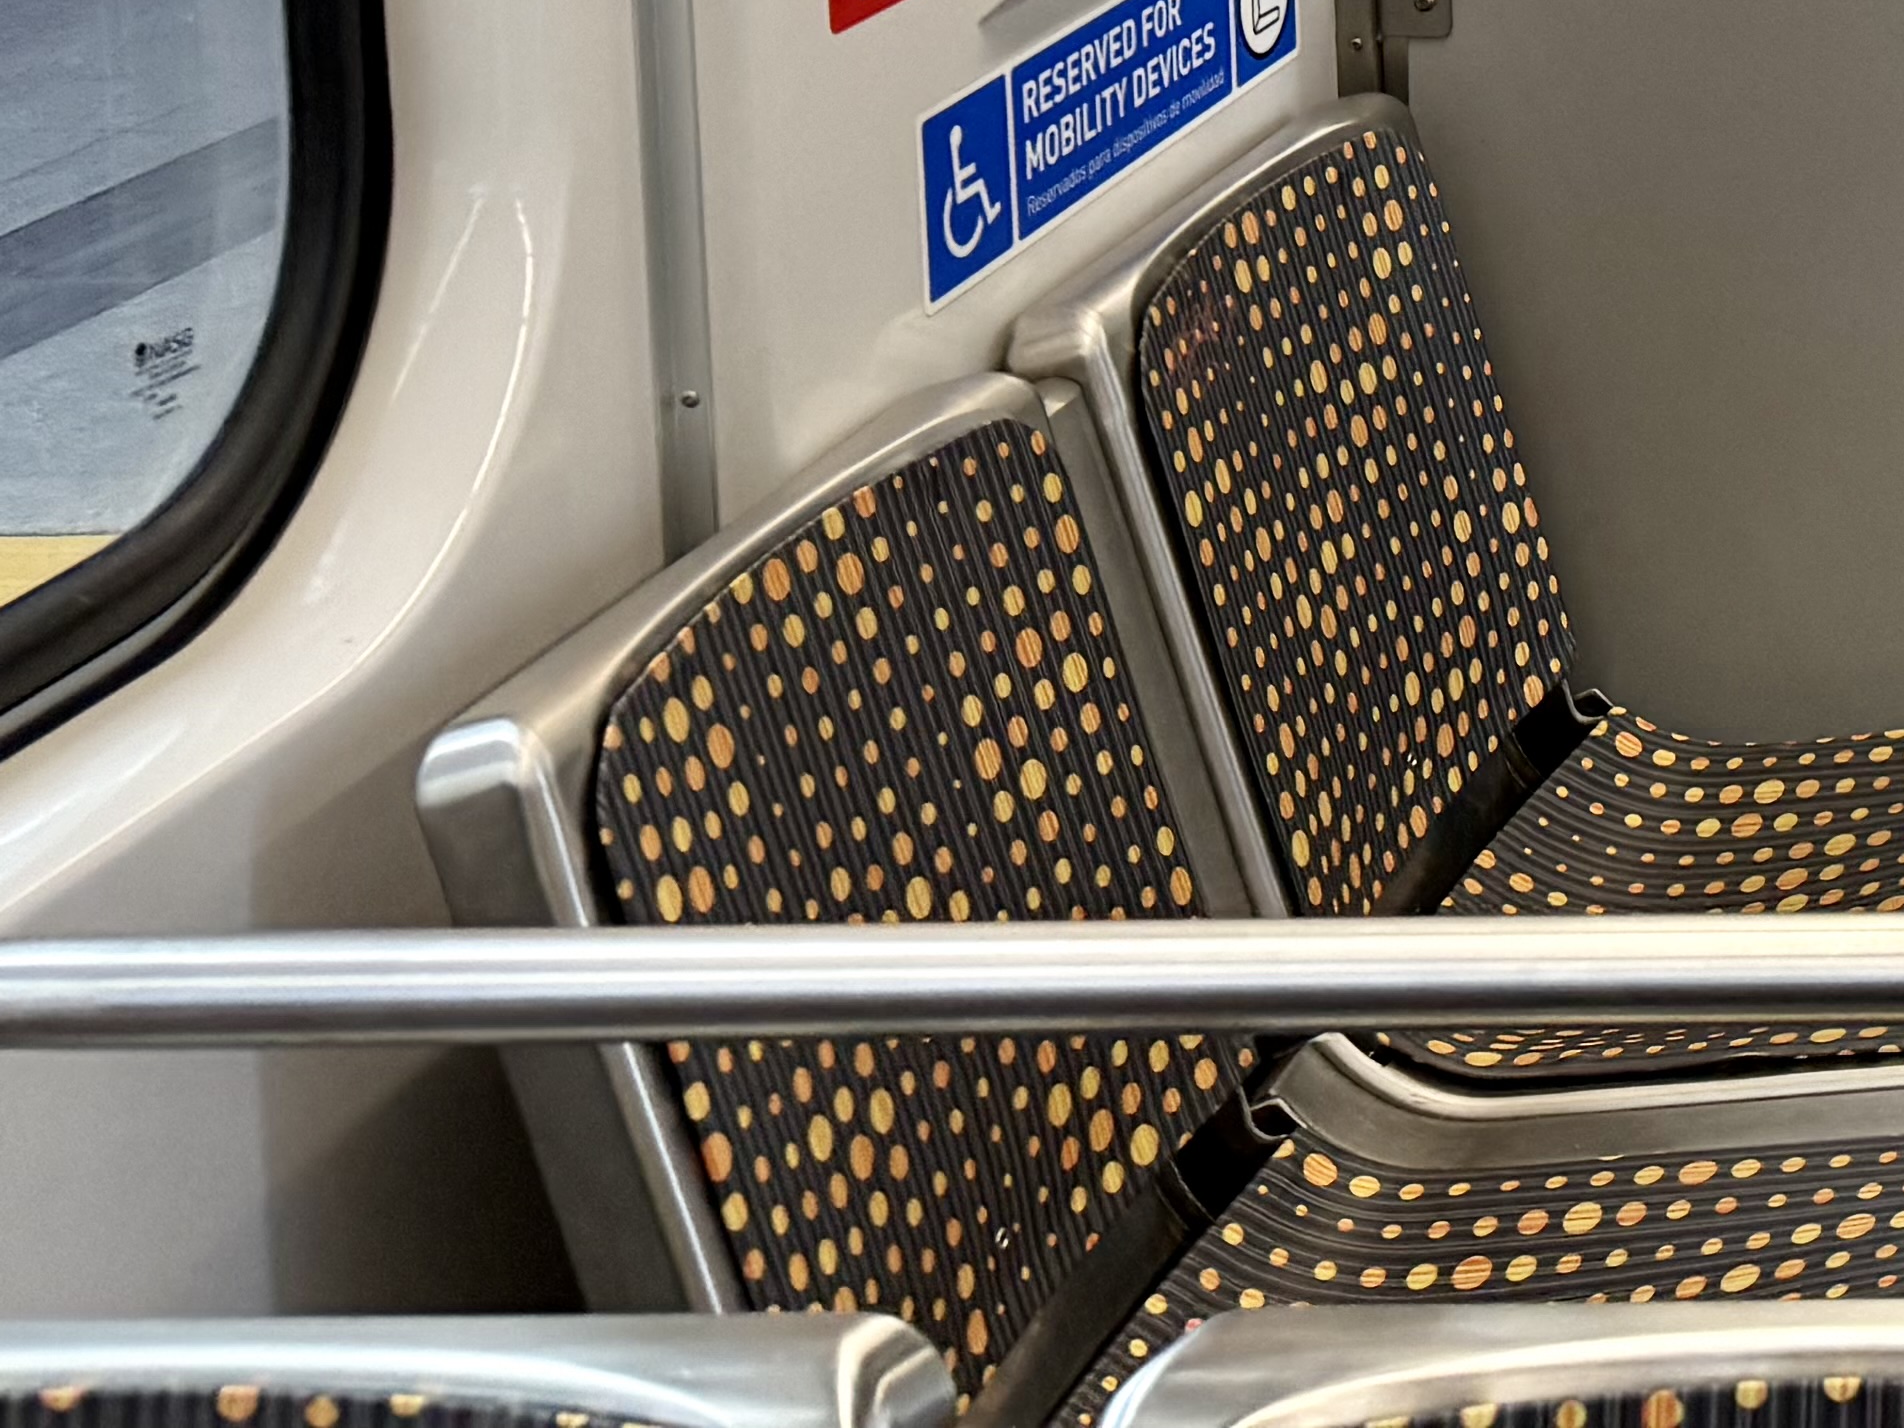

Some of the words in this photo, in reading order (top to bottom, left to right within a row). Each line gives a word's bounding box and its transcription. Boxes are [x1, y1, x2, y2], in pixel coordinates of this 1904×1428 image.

[1022, 18, 1137, 124] RESERVED
[1025, 76, 1128, 181] MOBILITY
[1132, 21, 1216, 109] DEVICES
